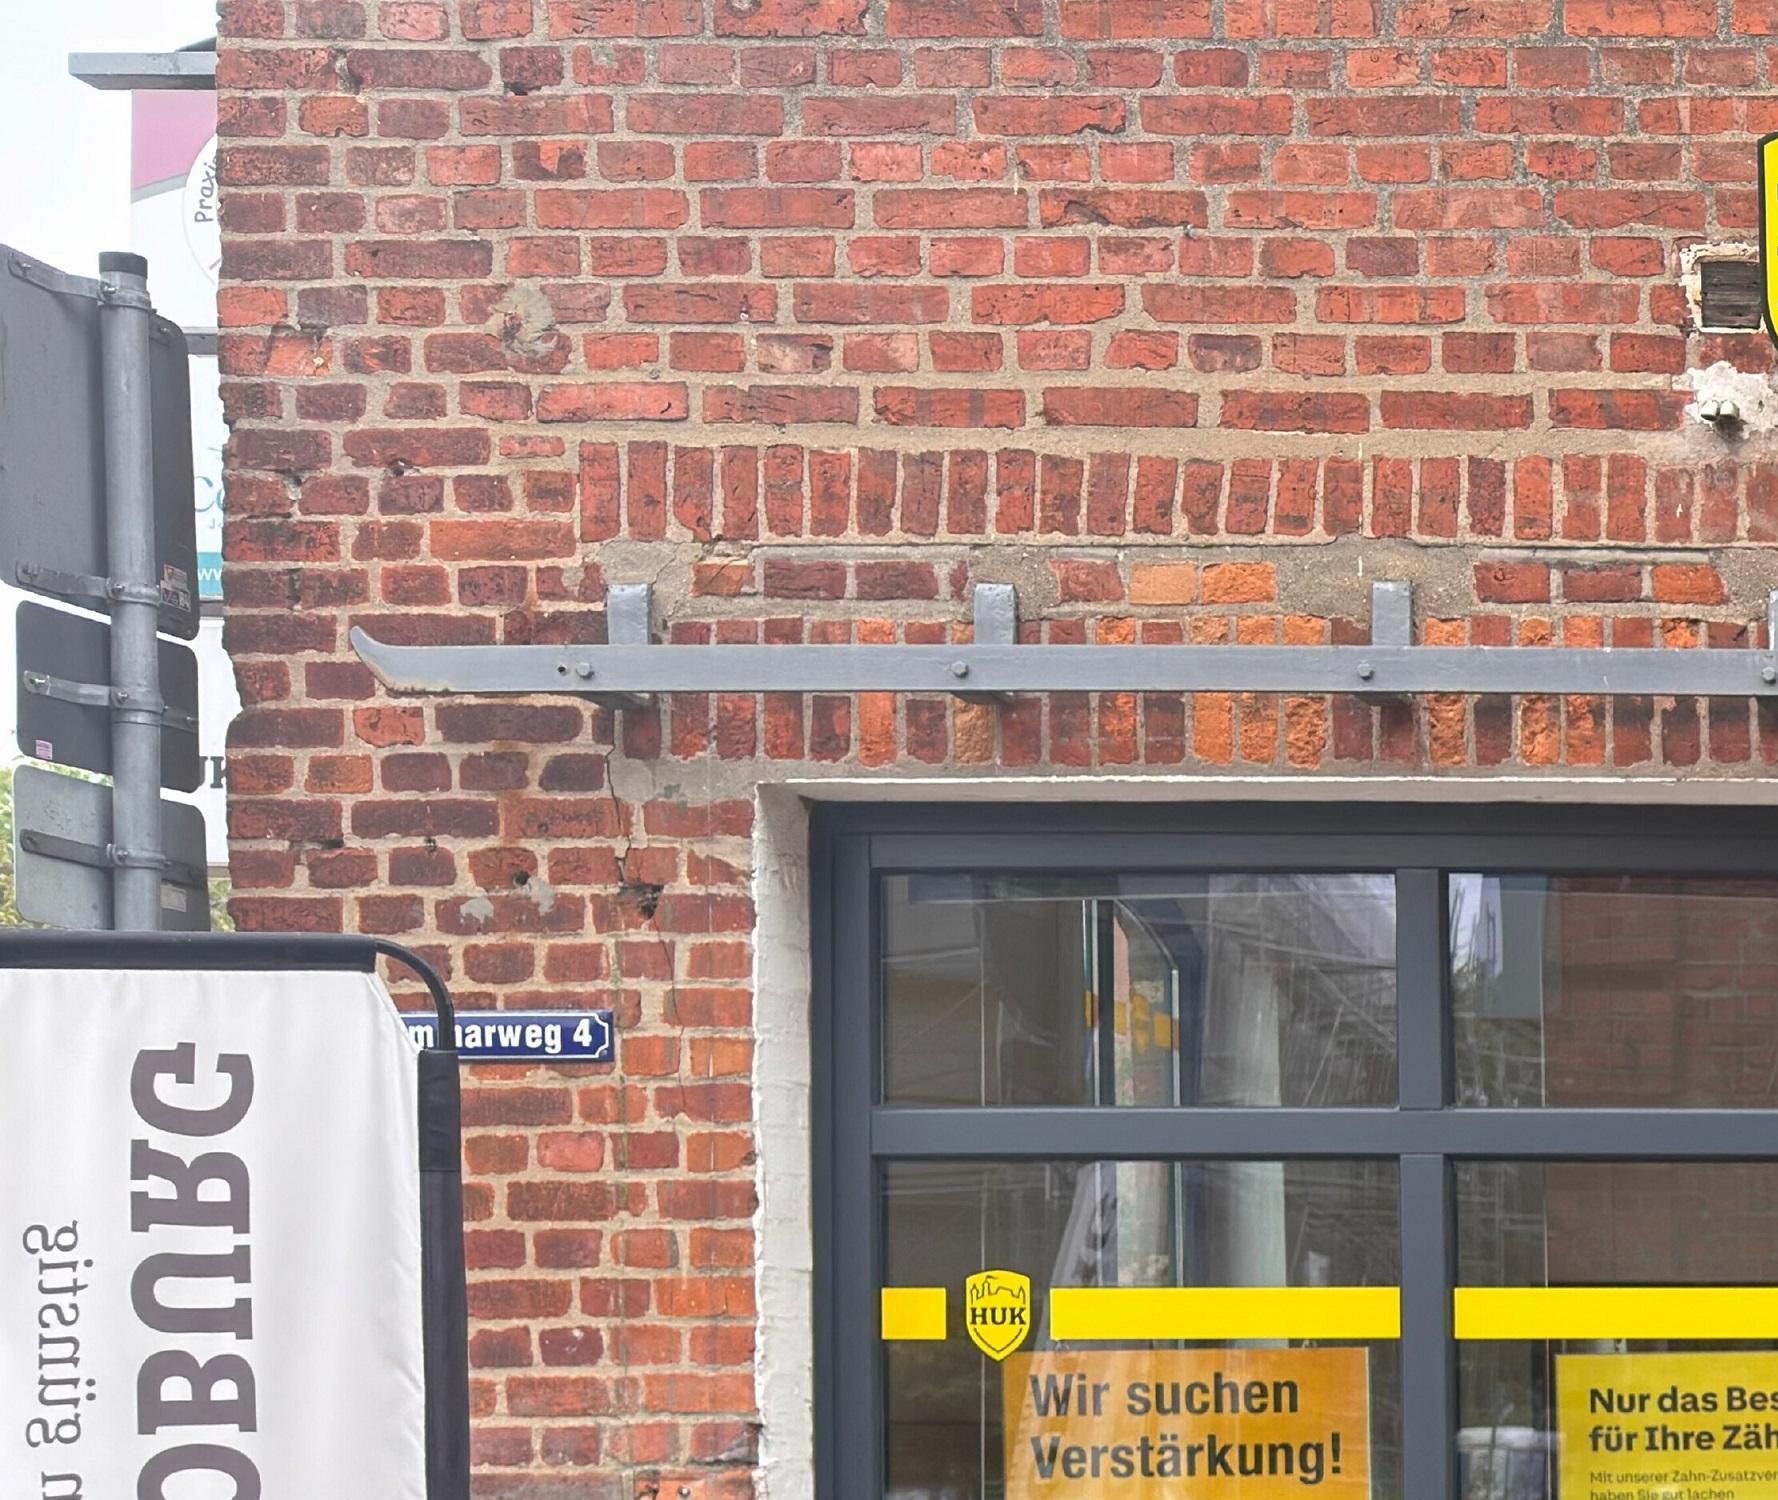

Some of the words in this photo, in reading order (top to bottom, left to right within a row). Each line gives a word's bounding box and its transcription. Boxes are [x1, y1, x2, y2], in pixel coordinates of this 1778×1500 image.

[573, 1019, 592, 1046] 4
[969, 1306, 1027, 1326] HUK
[1029, 1373, 1110, 1417] Wir
[1126, 1371, 1299, 1414] suchen
[1589, 1389, 1651, 1413] Nur
[1657, 1386, 1718, 1412] das
[1589, 1427, 1638, 1452] für
[1644, 1425, 1715, 1451] Ihre
[1029, 1431, 1342, 1485] Verstärkung!
[1590, 1472, 1612, 1484] Mit
[1617, 1474, 1669, 1483] unserer
[1638, 1490, 1659, 1500] Sie
[1687, 1488, 1734, 1500] lachen
